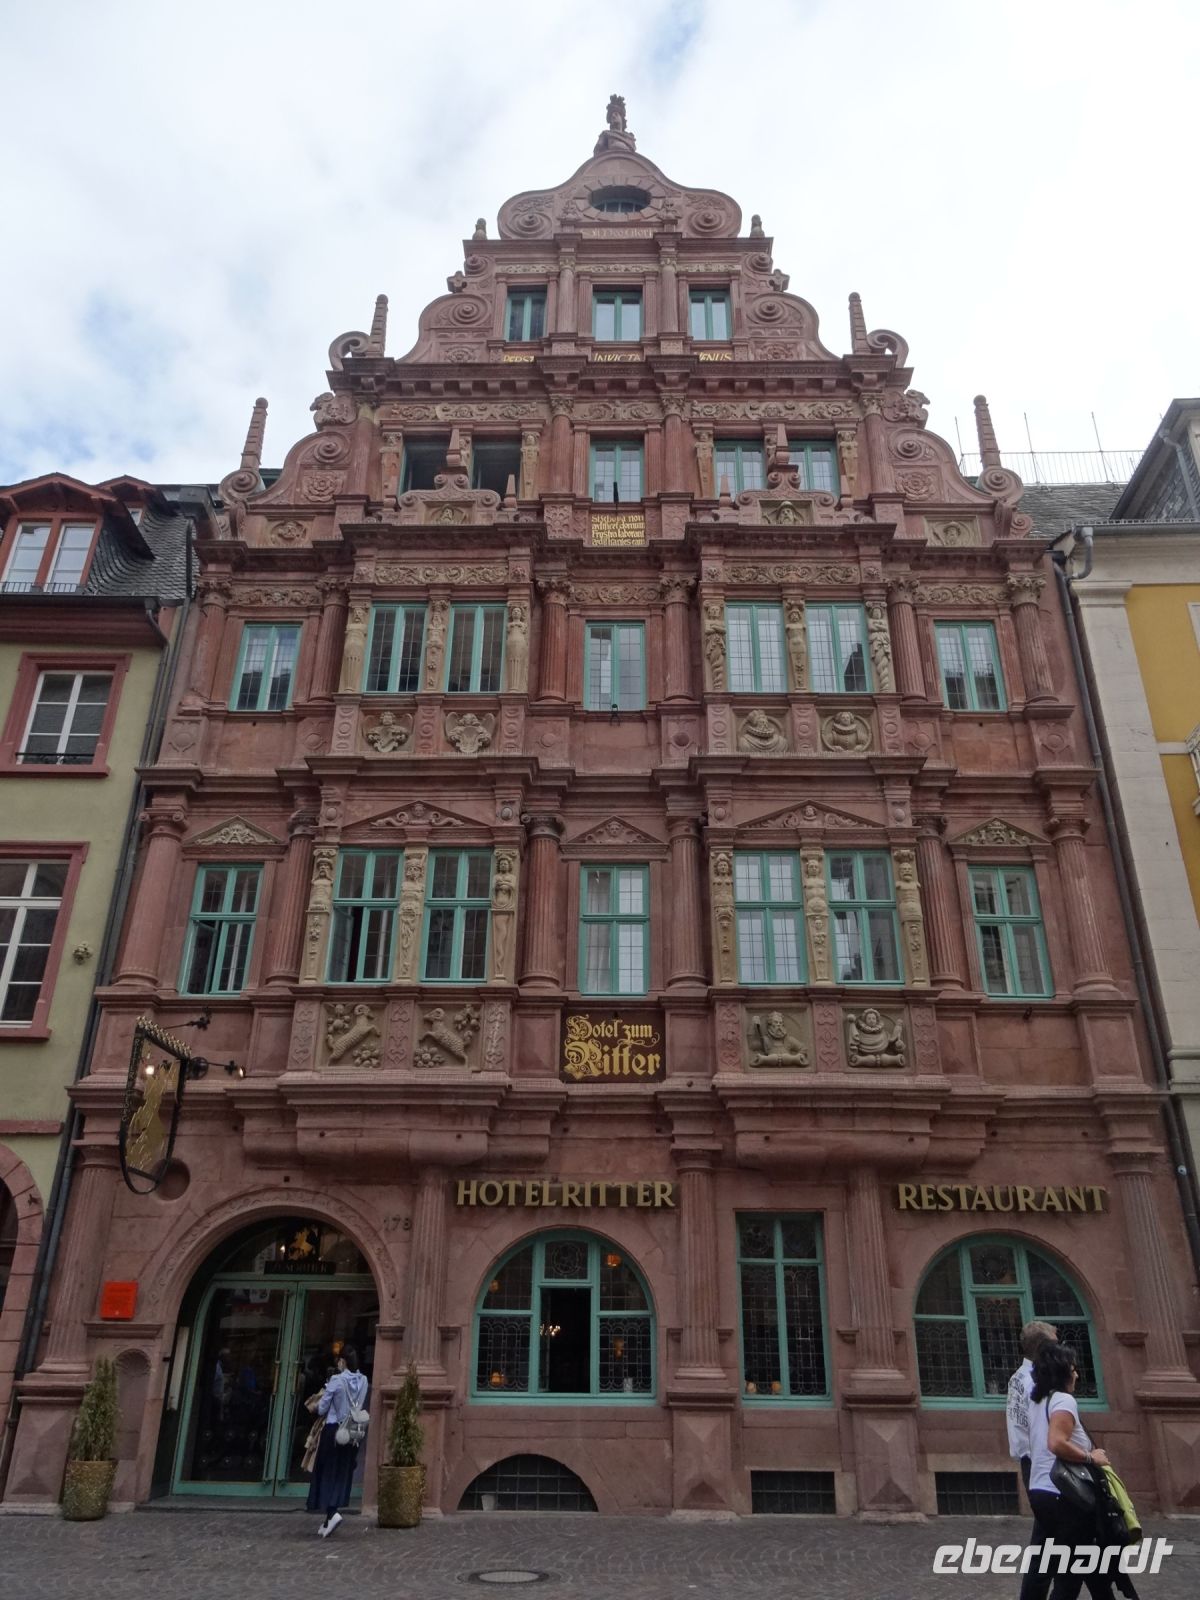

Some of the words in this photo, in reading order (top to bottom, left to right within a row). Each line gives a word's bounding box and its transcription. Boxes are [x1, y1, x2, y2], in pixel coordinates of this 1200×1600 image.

[566, 1014, 622, 1040] Hotel
[620, 1024, 658, 1045] zum
[564, 1039, 661, 1079] Ritter
[456, 1180, 557, 1206] HOTEL
[561, 1180, 676, 1207] RITTER
[897, 1183, 1108, 1212] RESTAURANT
